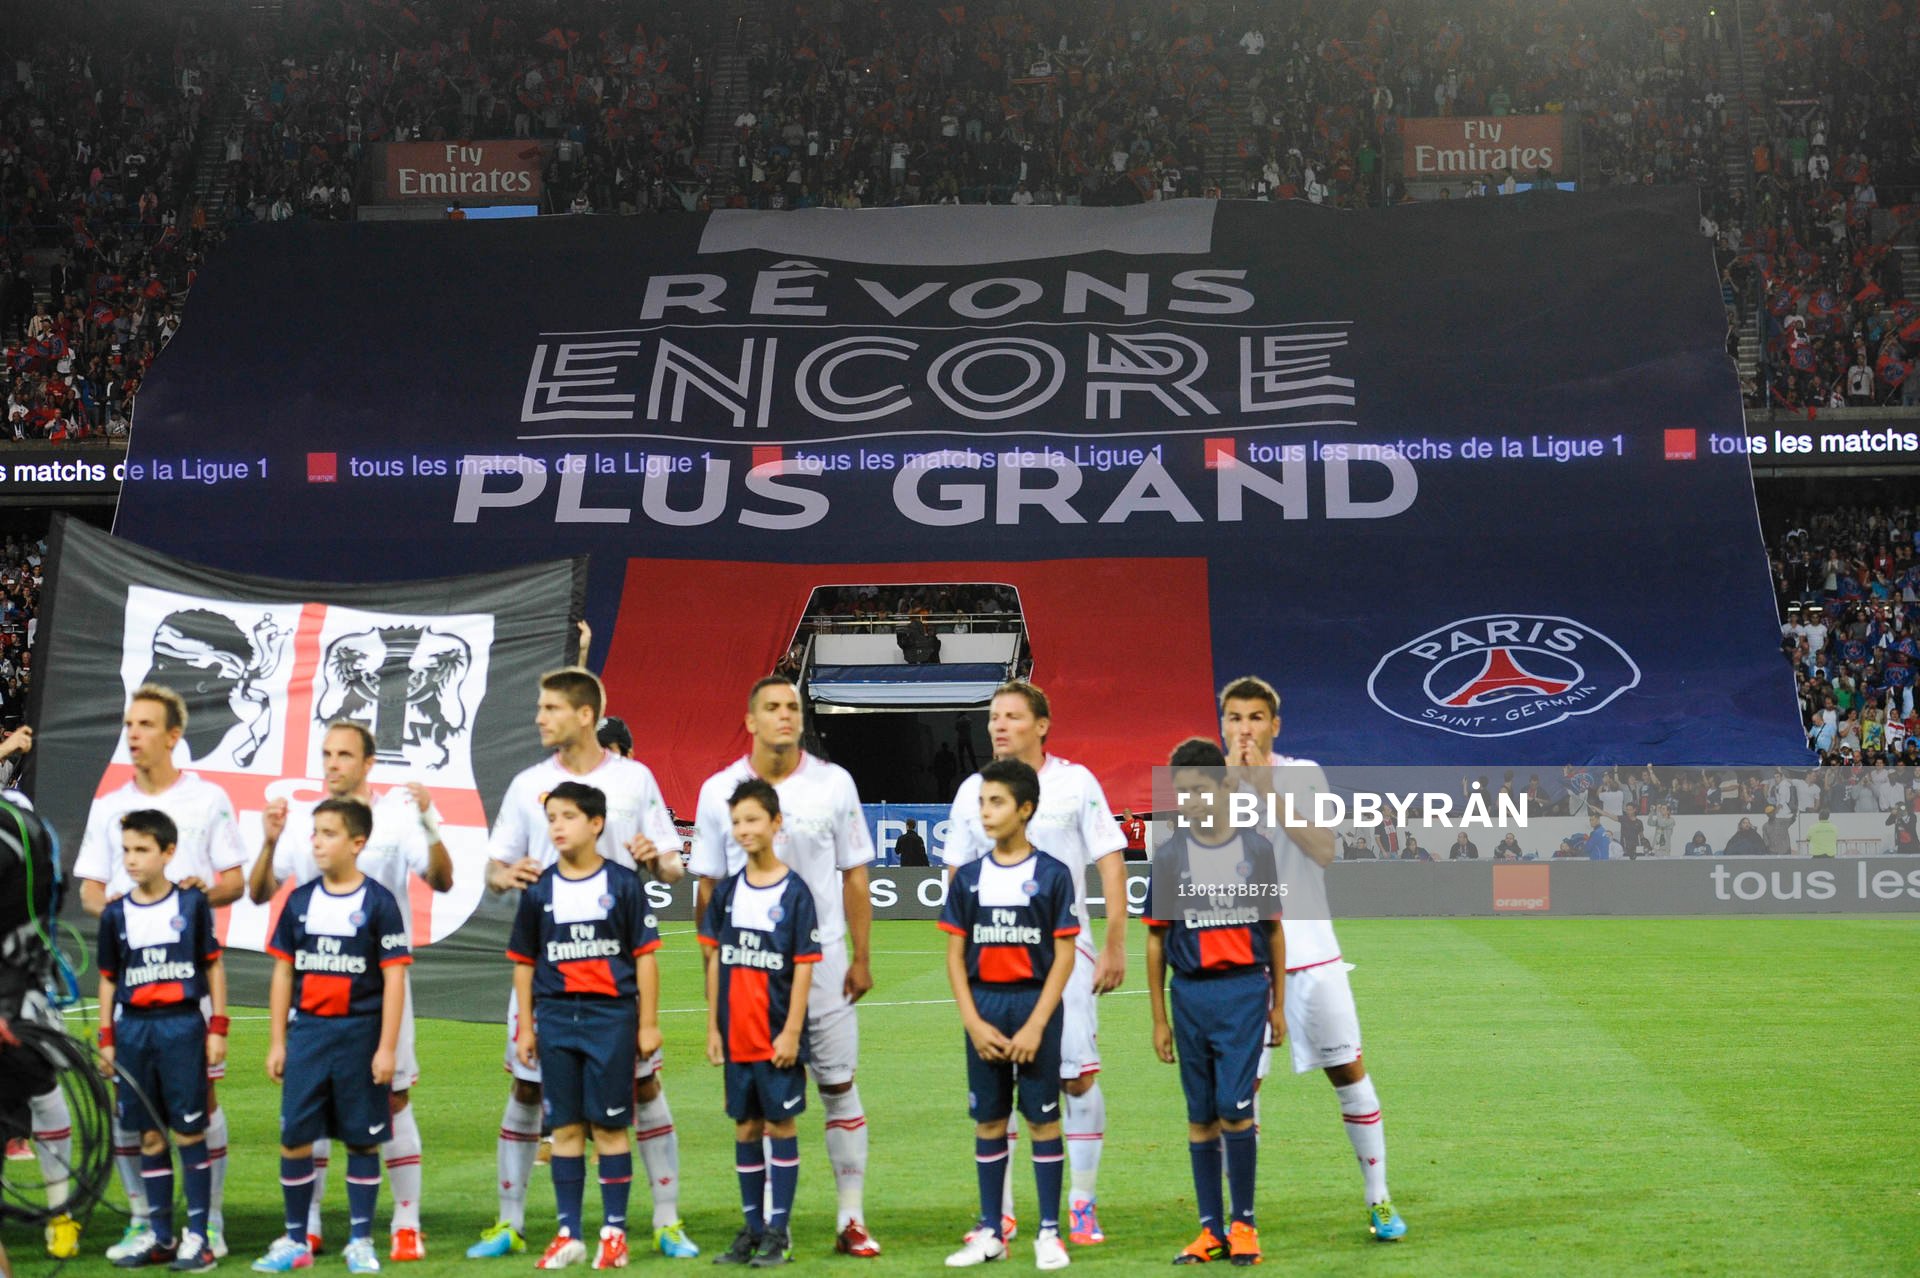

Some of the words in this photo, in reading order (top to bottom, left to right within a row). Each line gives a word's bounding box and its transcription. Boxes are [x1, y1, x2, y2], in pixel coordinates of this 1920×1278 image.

[1464, 121, 1502, 143] Fly
[446, 145, 484, 166] Fly
[1415, 143, 1553, 172] Emirates
[399, 166, 532, 194] Emirates
[640, 260, 1255, 319] RÊVONS
[520, 332, 1355, 428] ENCORE
[1248, 442, 1305, 463] tous
[1313, 439, 1349, 461] les
[1358, 436, 1453, 462] matchs
[1461, 436, 1494, 458] de
[1501, 436, 1523, 457] la
[1531, 435, 1604, 463] Ligue
[1612, 435, 1624, 456] 1
[1708, 433, 1768, 454] tous
[1774, 430, 1812, 454] les
[1820, 430, 1919, 454] matchs
[349, 457, 404, 477] tous
[413, 455, 448, 476] les
[595, 452, 617, 474] la
[625, 451, 693, 479] Ligue
[701, 451, 711, 472] 1
[794, 451, 852, 471] tous
[860, 448, 895, 470] les
[1044, 446, 1067, 468] la
[1074, 444, 1142, 473] Ligue
[14, 459, 106, 482] matchs
[113, 459, 145, 481] de
[152, 459, 174, 480] la
[182, 458, 249, 485] Ligue
[257, 458, 268, 478] 1
[453, 454, 830, 530] PLUS
[892, 444, 1419, 527] GRAND
[1409, 620, 1584, 660] PARIS
[1710, 864, 1837, 900] tous
[1496, 898, 1544, 909] orange
[992, 908, 1017, 926] Fly
[570, 923, 595, 940] Fly
[973, 923, 1041, 944] Emirates
[142, 948, 167, 963] Fly
[317, 936, 342, 955] Fly
[547, 938, 621, 962] Emirates
[295, 949, 367, 973] Emirates
